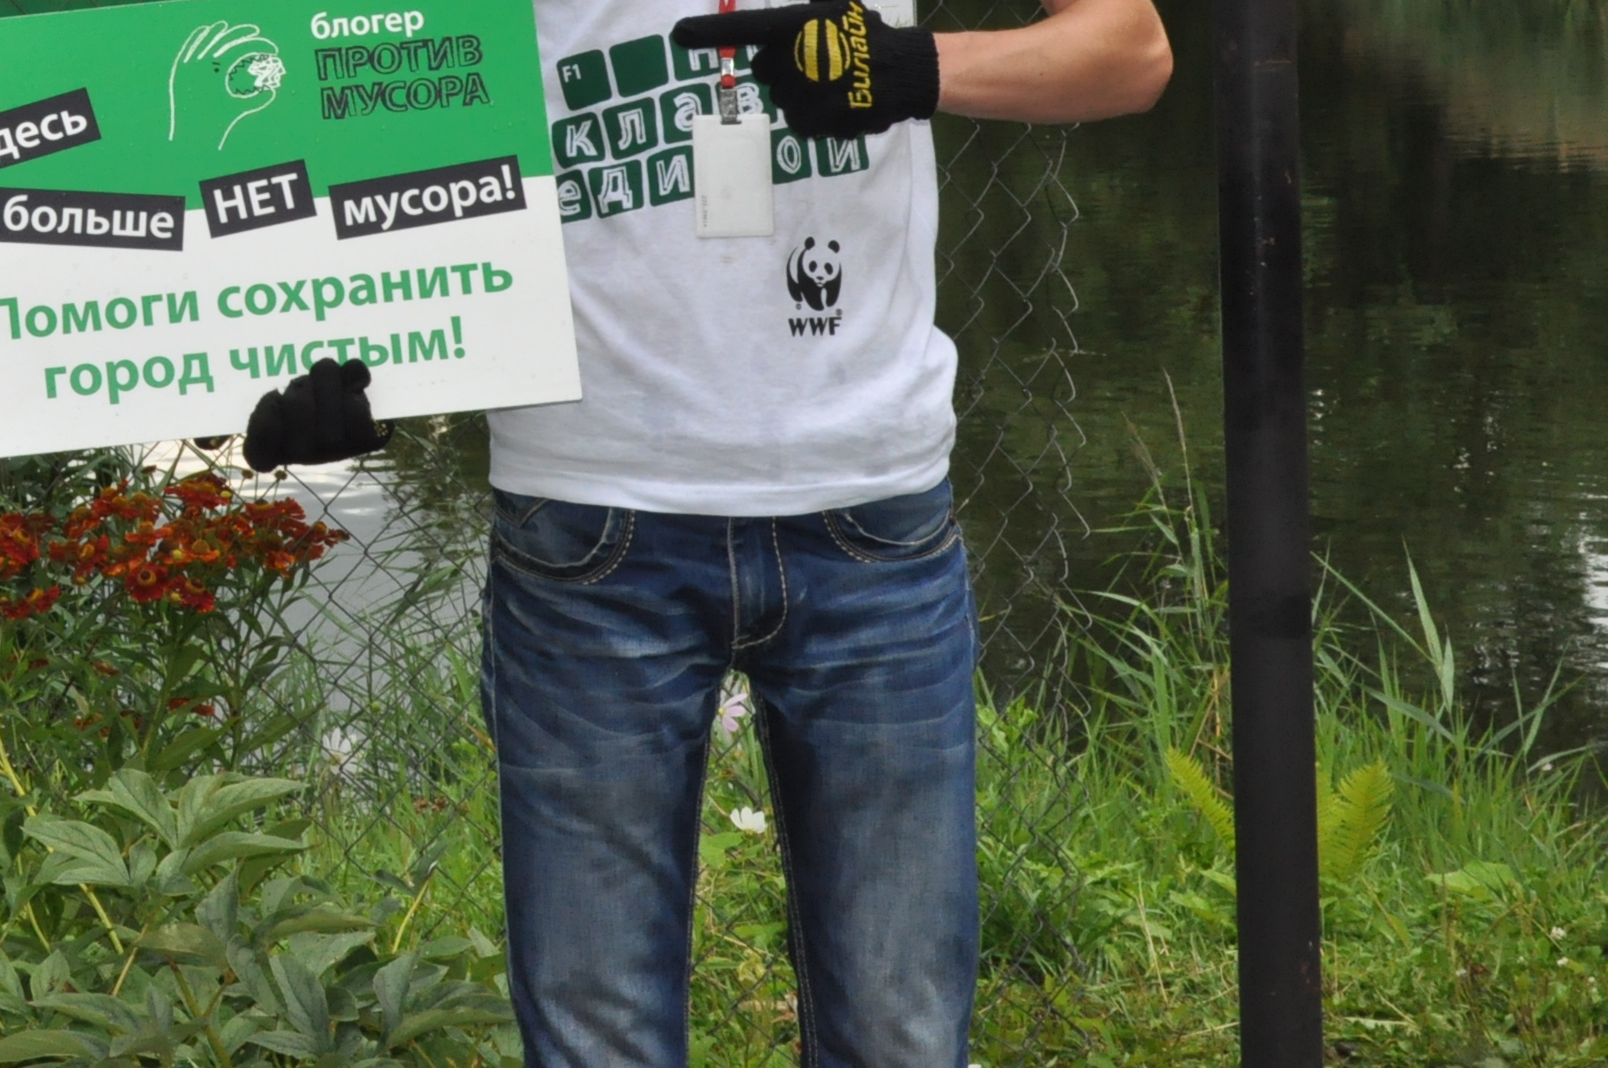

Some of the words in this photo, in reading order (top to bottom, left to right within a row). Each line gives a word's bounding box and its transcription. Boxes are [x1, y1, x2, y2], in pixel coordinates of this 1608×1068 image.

[310, 10, 425, 39] блогер
[314, 34, 483, 81] ПРОТИВ
[561, 63, 582, 83] F1
[320, 72, 491, 120] МУСОРА
[2, 194, 175, 239] больше
[212, 173, 298, 224] НЕТ
[343, 164, 517, 231] мусора!
[217, 261, 514, 322] сохранить
[788, 316, 843, 337] WWF
[44, 351, 215, 405] город
[229, 315, 466, 379] чистым!
